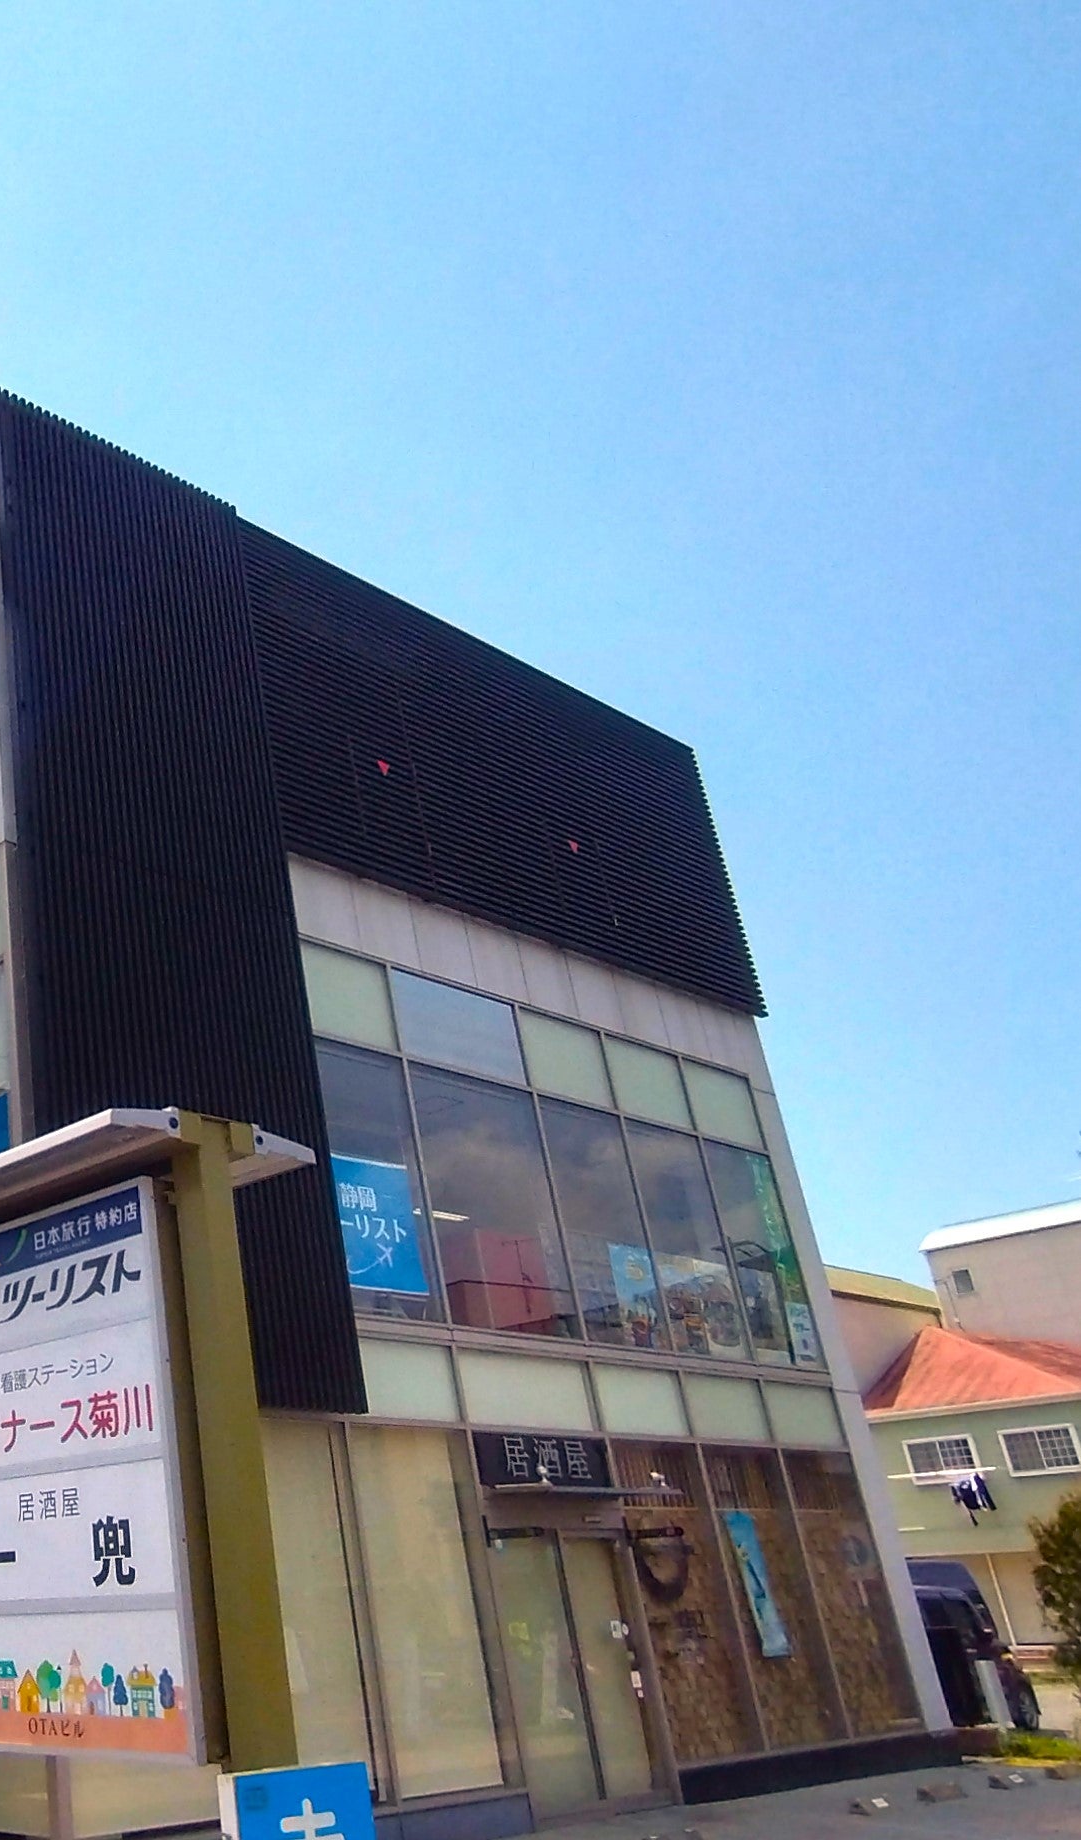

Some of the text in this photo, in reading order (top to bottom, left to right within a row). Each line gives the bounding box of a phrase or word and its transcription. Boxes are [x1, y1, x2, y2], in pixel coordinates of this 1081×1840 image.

[339, 1183, 377, 1212] 静岡
[503, 1435, 592, 1479] 居酒屋
[18, 1488, 81, 1523] 居酒屋
[28, 1717, 85, 1738] OTAビル
